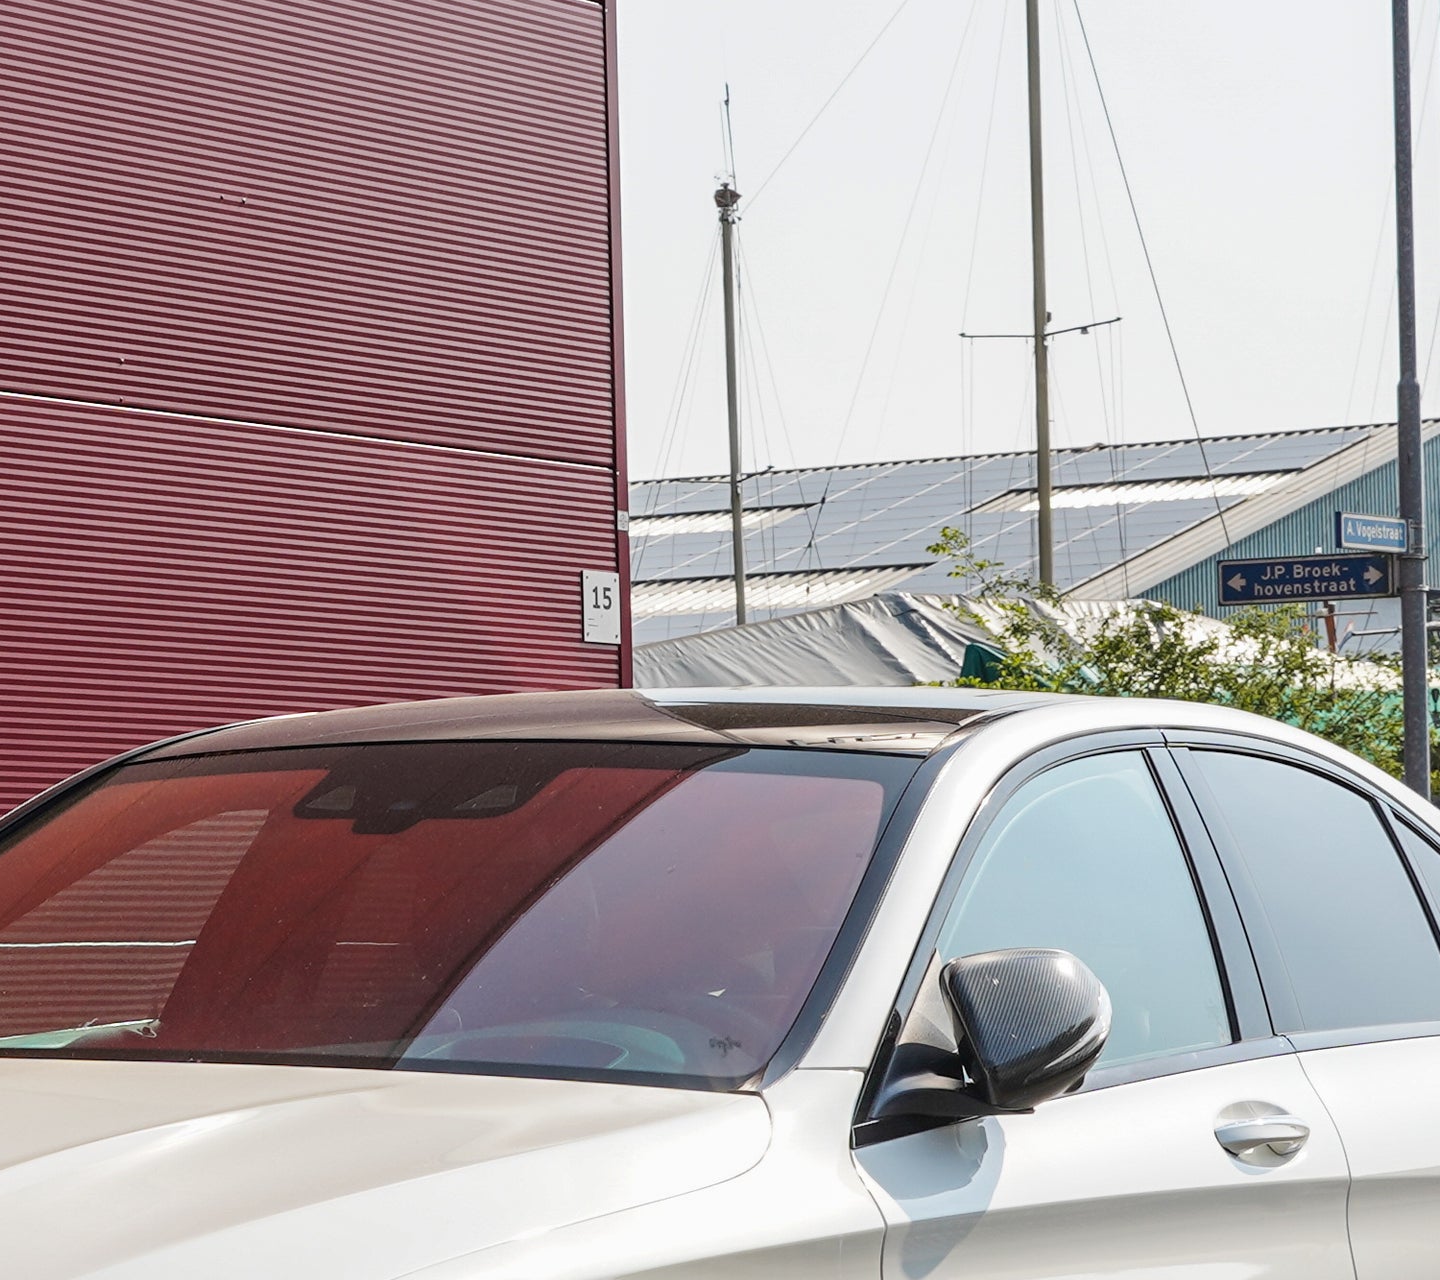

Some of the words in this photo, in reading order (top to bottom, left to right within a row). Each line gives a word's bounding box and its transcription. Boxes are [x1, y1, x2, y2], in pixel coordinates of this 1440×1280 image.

[1356, 521, 1404, 542] Vogelstraat
[1261, 565, 1290, 580] J.P.
[1293, 562, 1349, 579] Broek-
[1254, 578, 1356, 596] hovenstraat
[592, 586, 612, 610] 15
